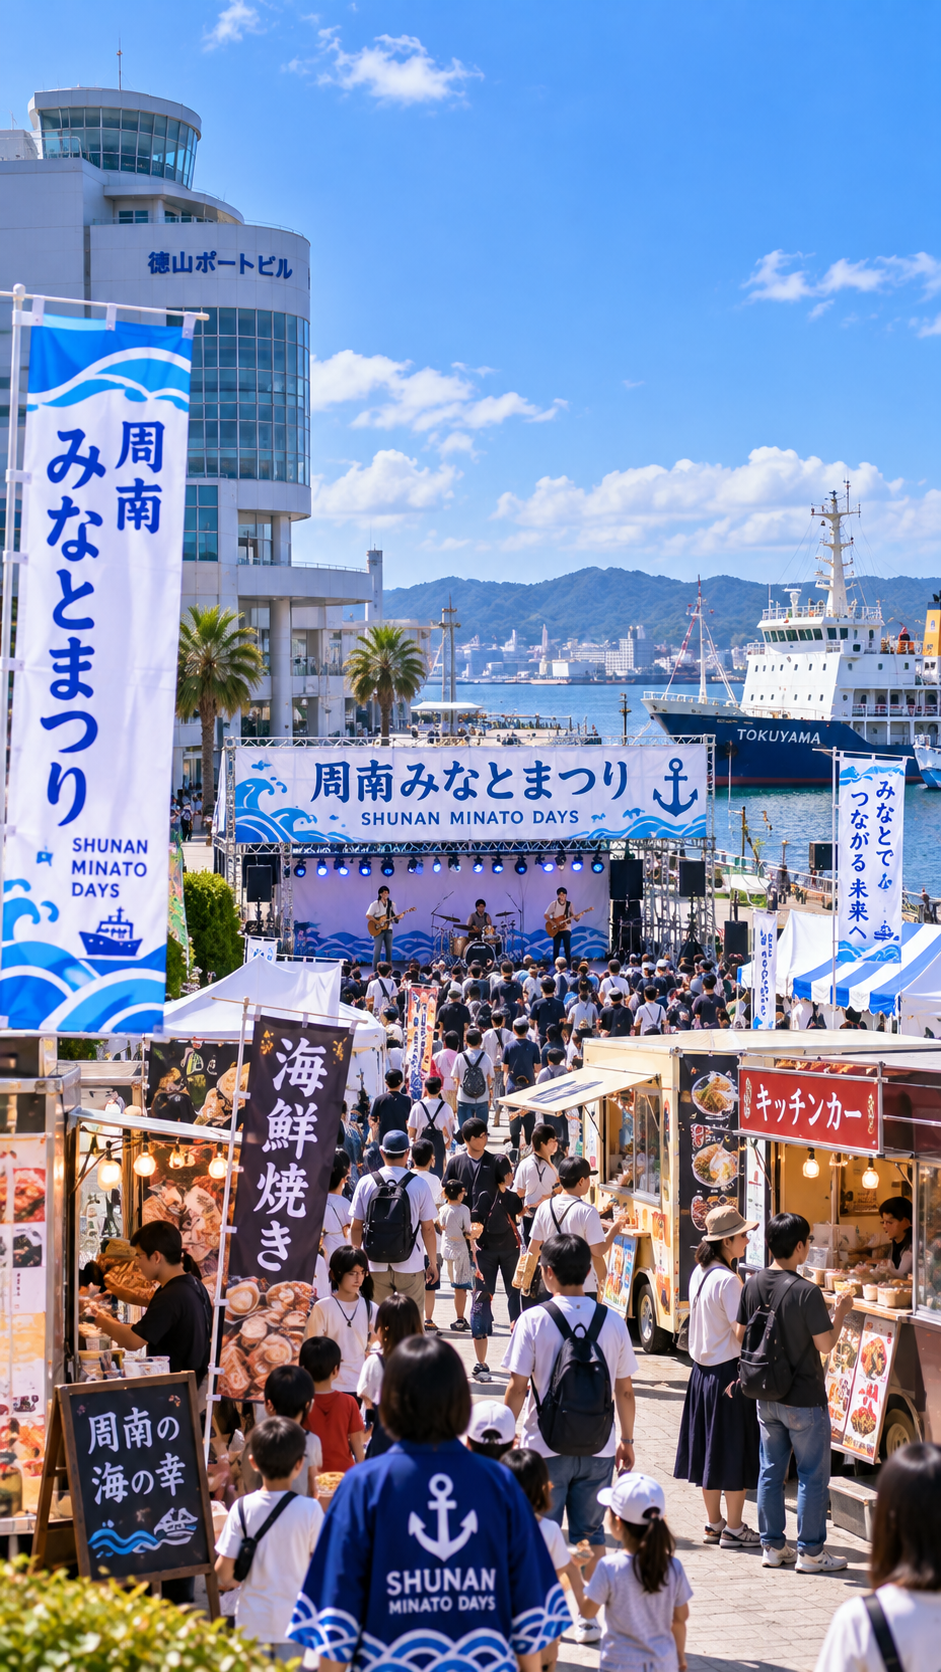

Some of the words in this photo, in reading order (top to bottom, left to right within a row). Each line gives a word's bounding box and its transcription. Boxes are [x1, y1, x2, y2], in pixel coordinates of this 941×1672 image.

[147, 249, 293, 280] 徳山ポートビル
[114, 420, 165, 534] 周南
[39, 428, 107, 827] みなとまつり
[737, 728, 821, 745] TOKUYAMA
[310, 759, 628, 804] 周南みなとまつり
[361, 811, 440, 826] SHUNAN
[450, 810, 524, 825] MINATO
[532, 809, 579, 824] DAYS
[875, 780, 896, 867] みなとで
[72, 837, 148, 854] SHUNAN
[71, 859, 147, 878] MINATO
[71, 882, 120, 899] DAYS
[755, 1083, 862, 1131] キッチンカー
[253, 1036, 328, 1272] 海鮮焼き
[88, 1407, 180, 1455] 周南の
[91, 1453, 186, 1505] 海の幸
[387, 1568, 496, 1595] SHUNAN
[388, 1596, 452, 1614] MINATO
[459, 1595, 496, 1611] DAYS
